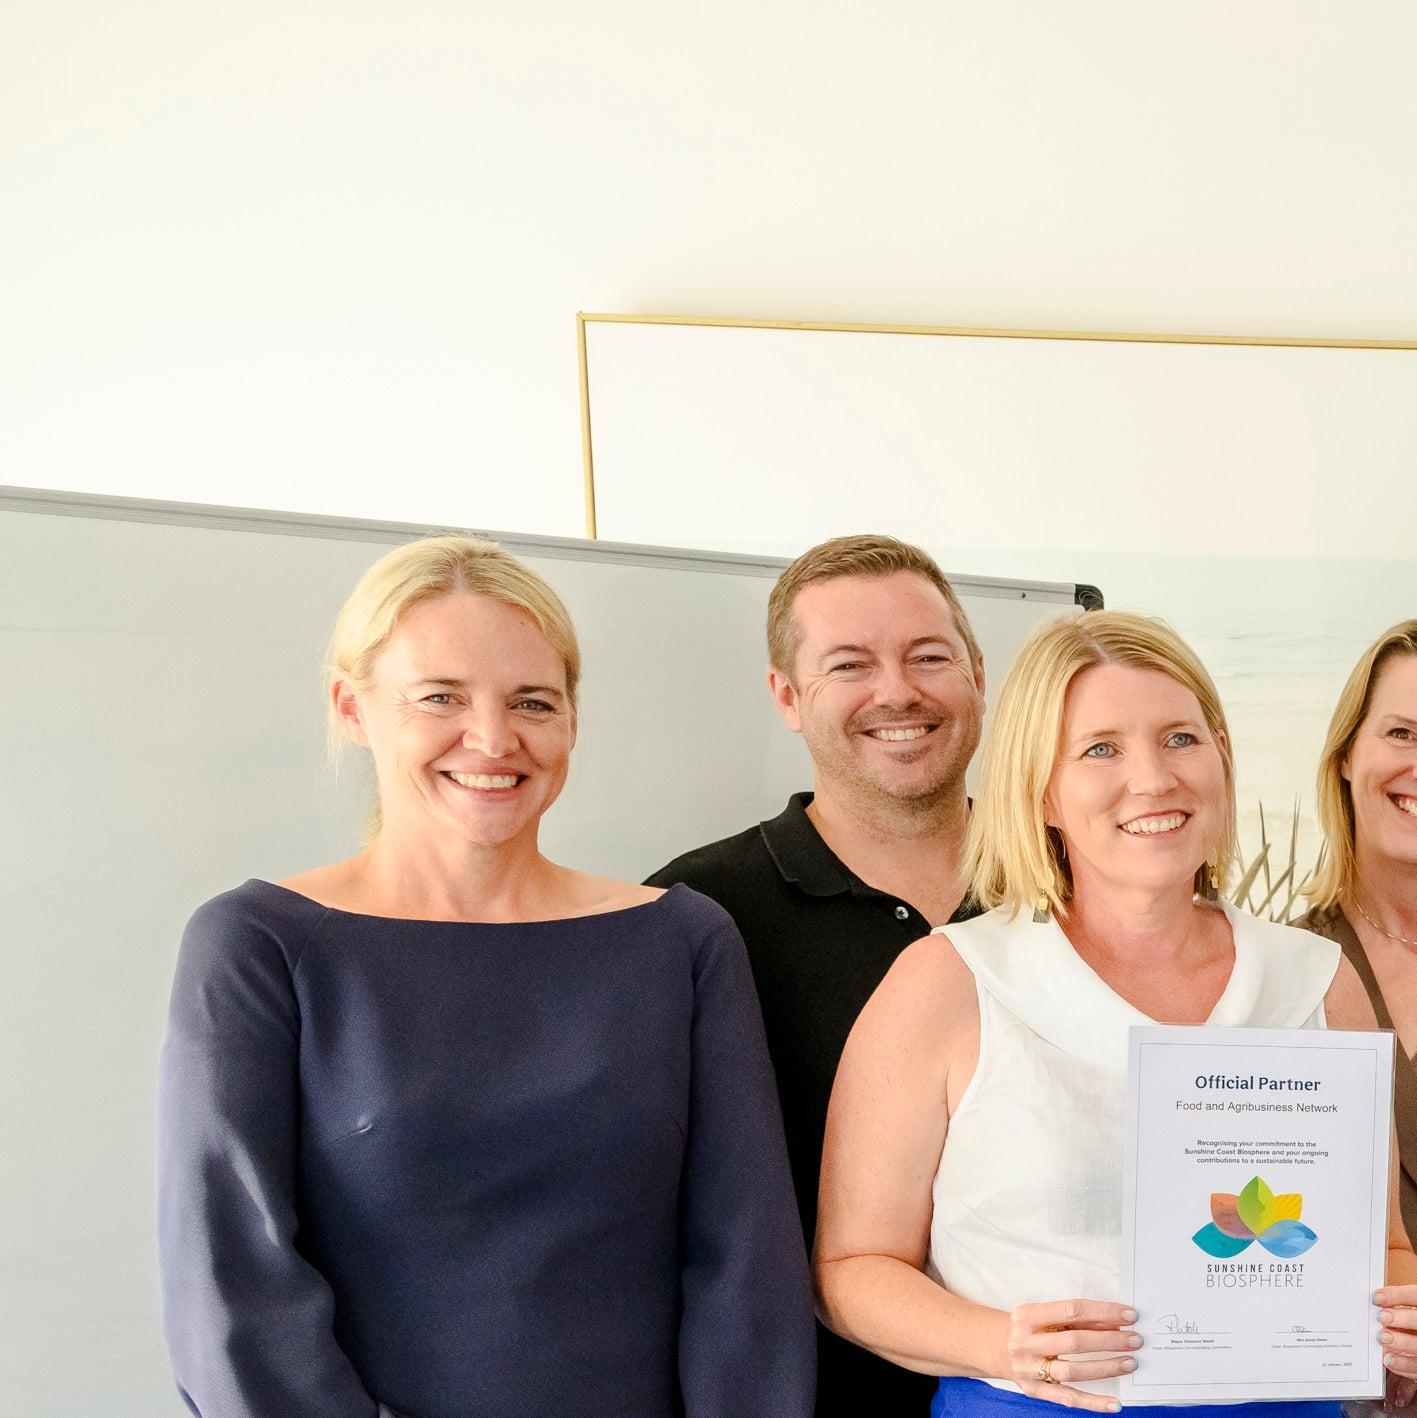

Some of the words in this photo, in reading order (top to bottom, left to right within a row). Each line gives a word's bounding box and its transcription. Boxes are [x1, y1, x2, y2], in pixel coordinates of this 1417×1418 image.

[1195, 1075, 1254, 1089] Official
[1259, 1078, 1321, 1091] Partner
[1176, 1101, 1202, 1111] Food
[1205, 1102, 1224, 1111] and
[1228, 1102, 1293, 1113] Agribusiness
[1297, 1103, 1338, 1112] Network
[1207, 1264, 1263, 1272] SUNSHINE
[1270, 1264, 1304, 1272] COAST
[1207, 1273, 1304, 1288] BIOSPHERE
